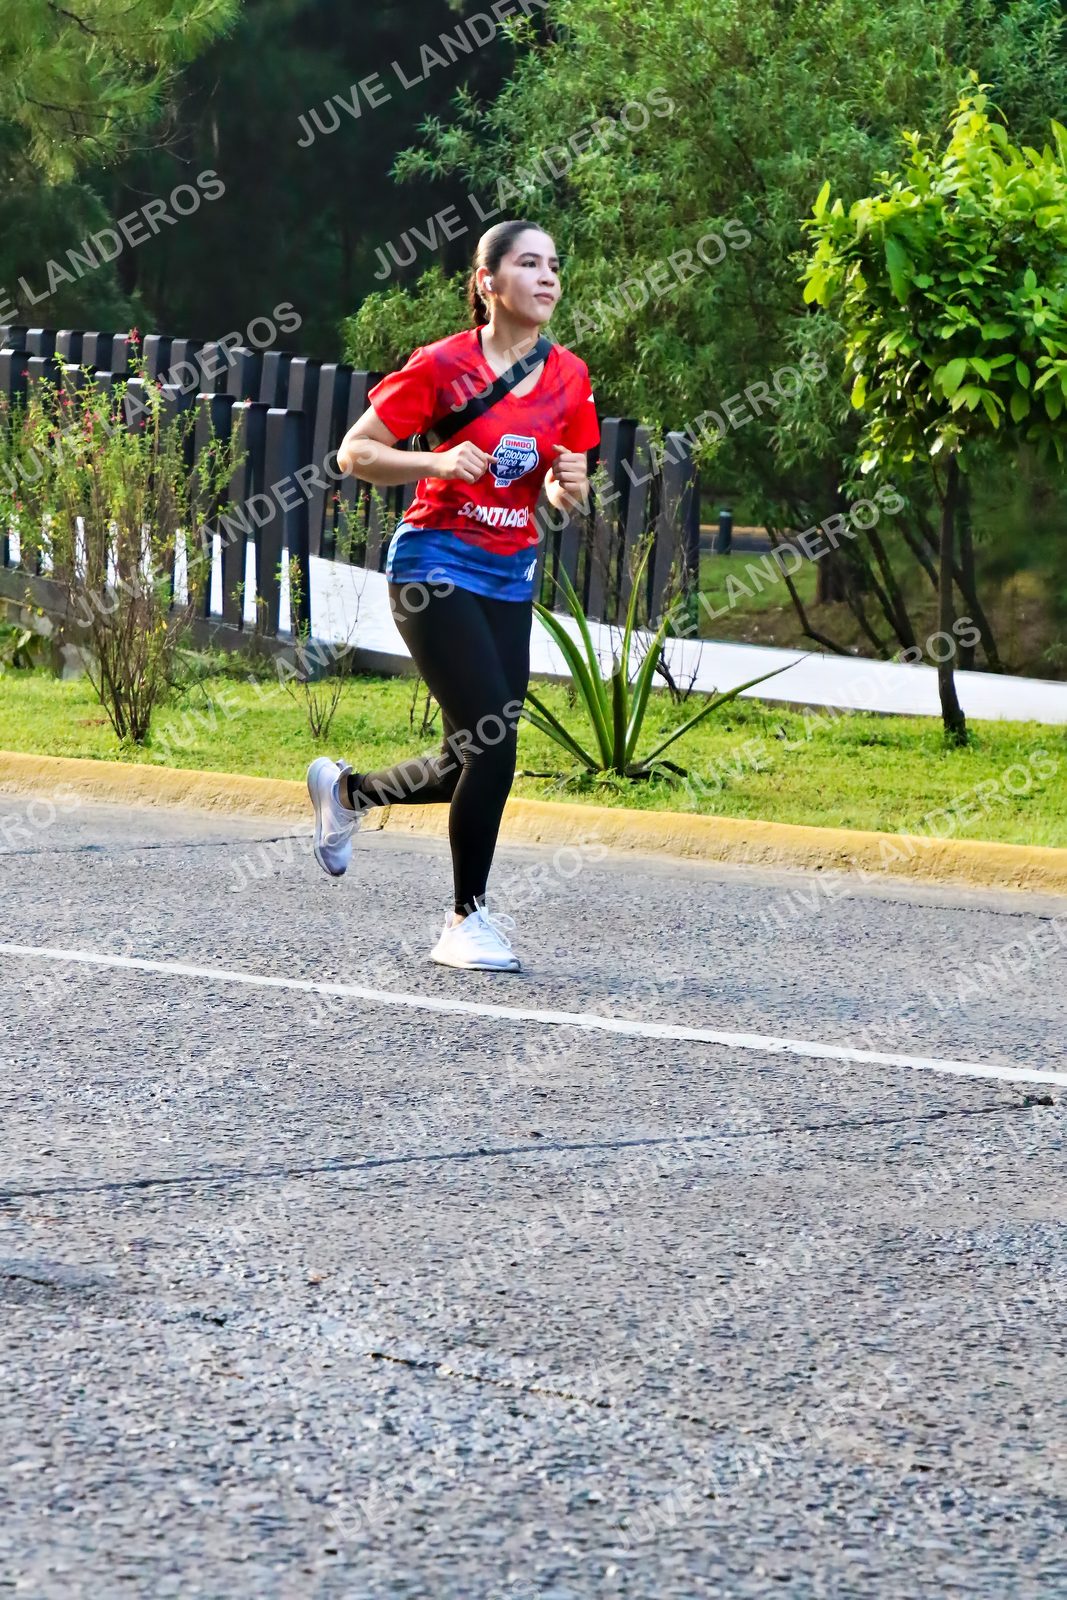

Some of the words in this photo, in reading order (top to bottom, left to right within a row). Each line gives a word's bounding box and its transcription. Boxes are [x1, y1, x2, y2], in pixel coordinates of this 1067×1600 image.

[504, 439, 532, 449] BIMBO
[503, 449, 530, 461] Global
[497, 456, 518, 467] Race
